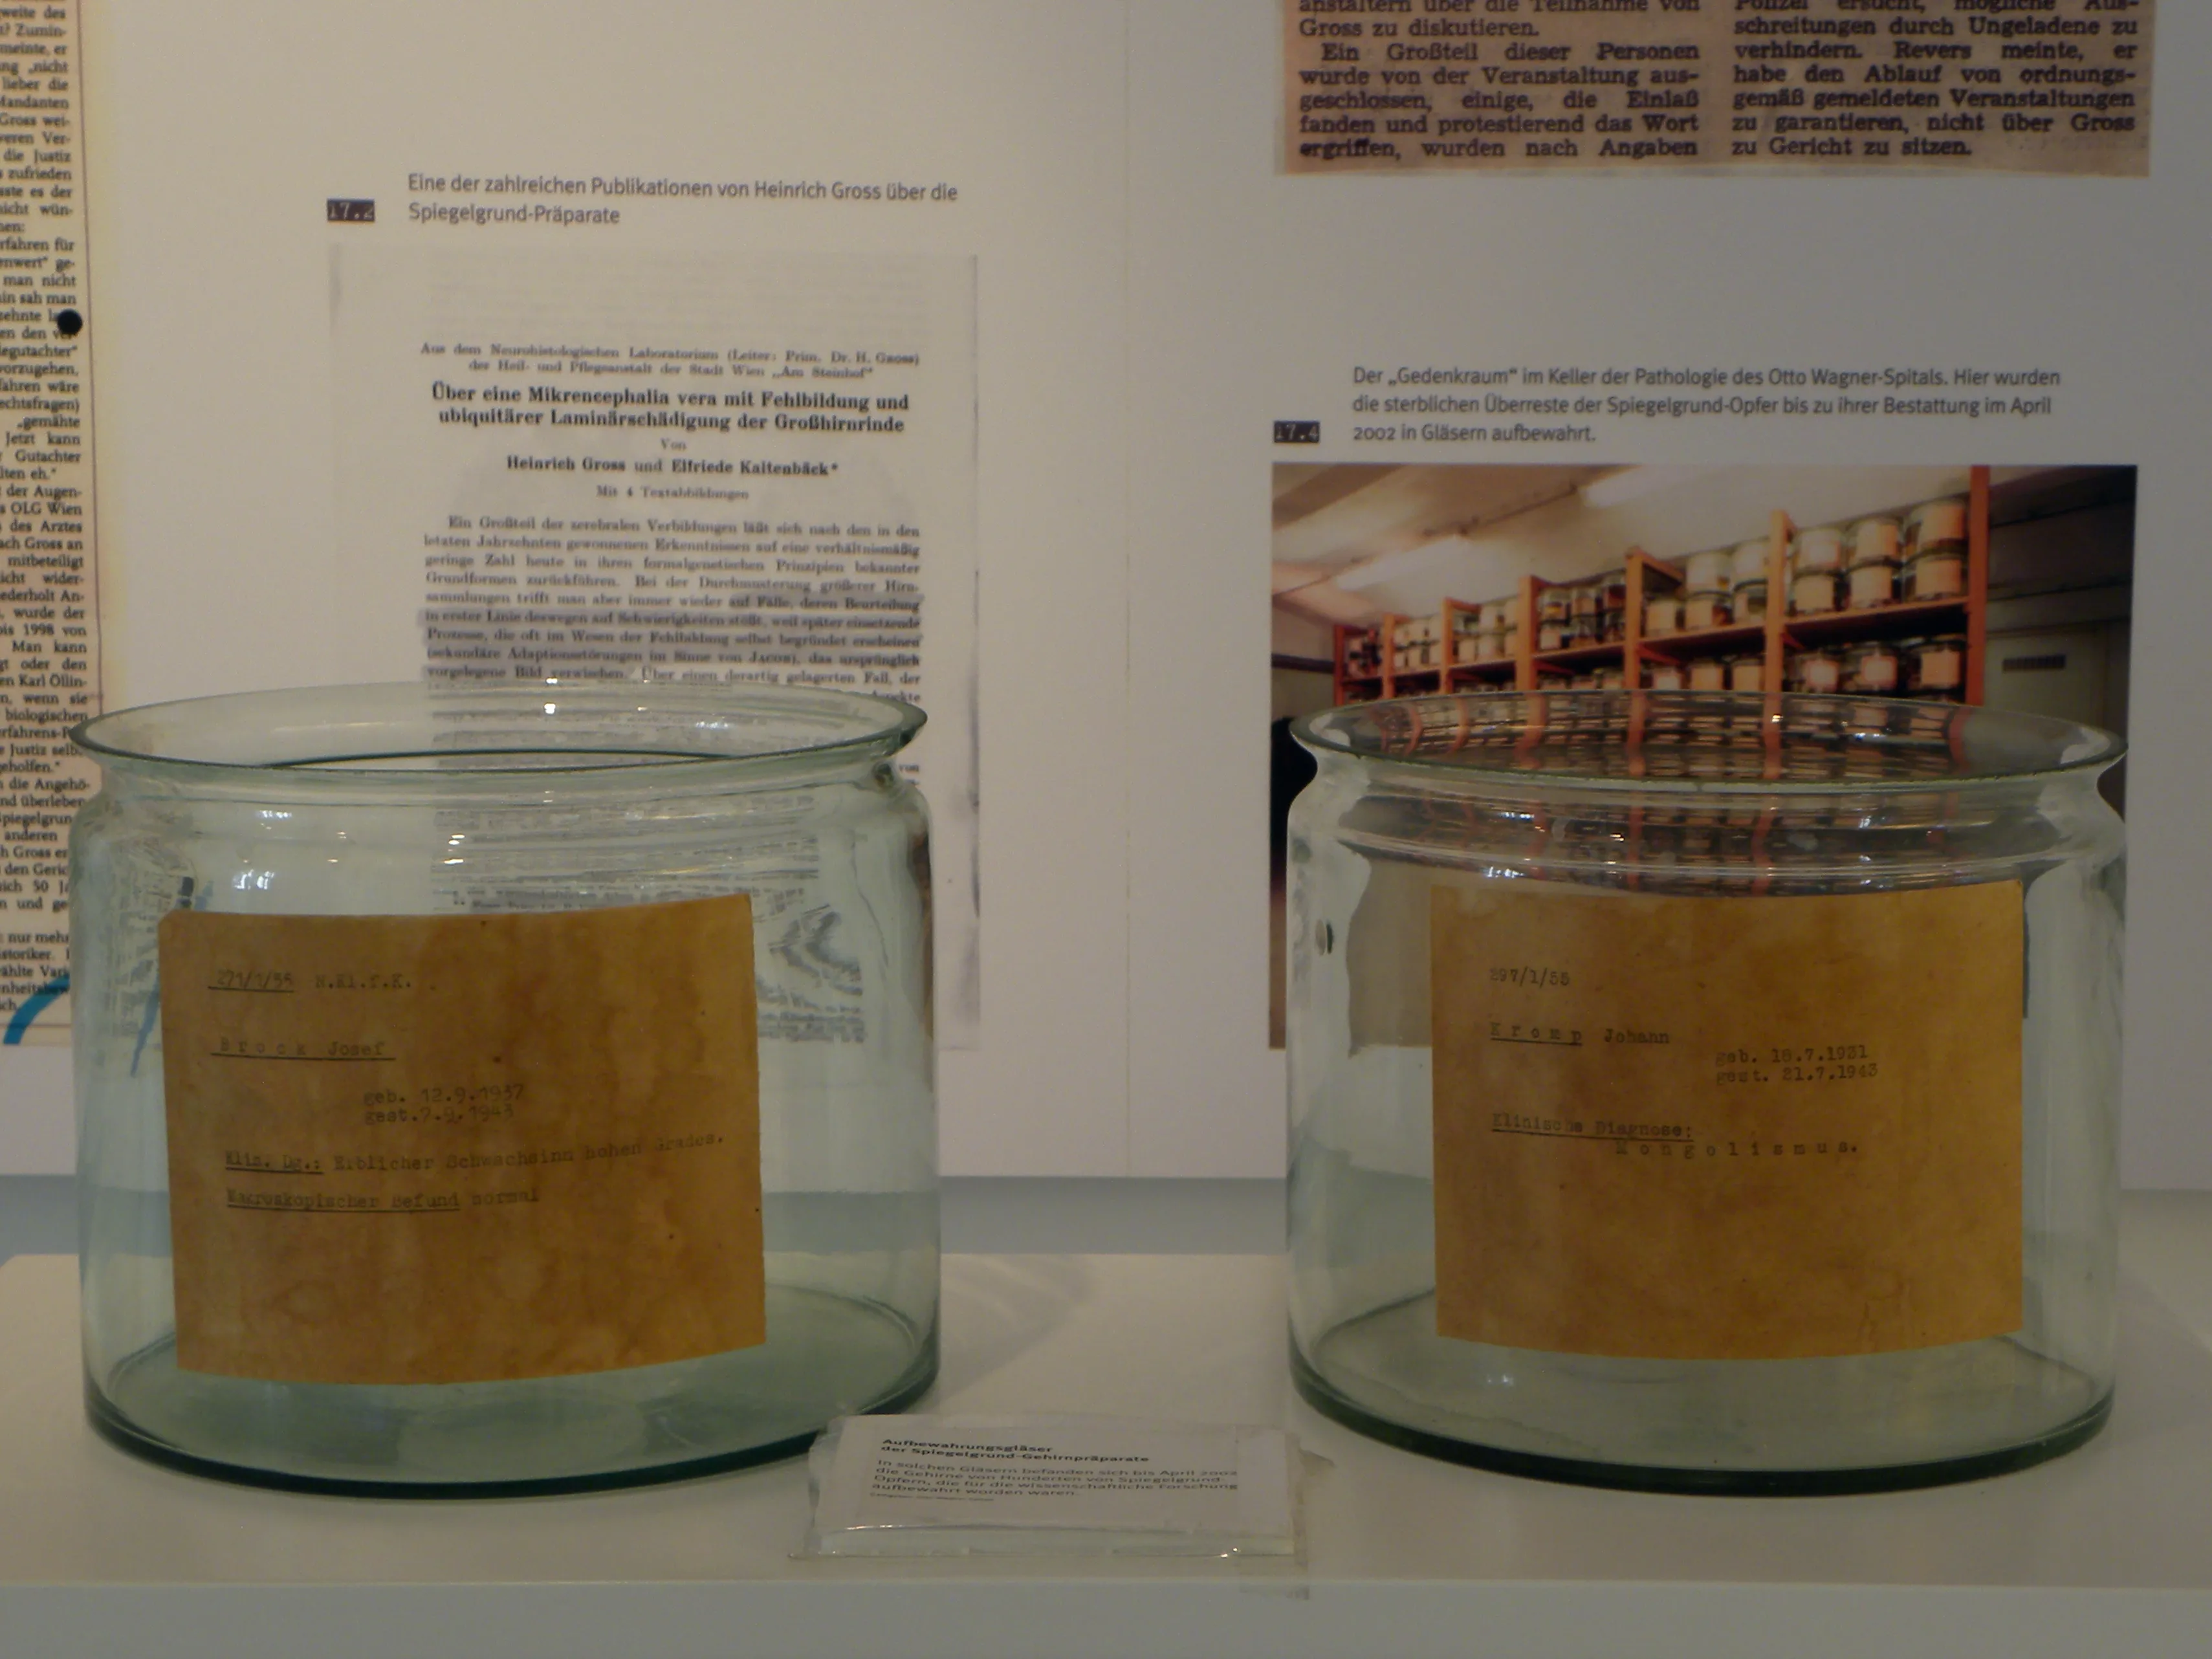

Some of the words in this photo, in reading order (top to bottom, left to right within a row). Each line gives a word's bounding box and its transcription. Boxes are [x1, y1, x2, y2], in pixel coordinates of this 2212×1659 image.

[1733, 16, 1877, 38] schreitungen
[1888, 16, 1955, 36] durch
[1967, 15, 2101, 39] Ungeladene
[2111, 20, 2138, 36] zu
[1298, 66, 1371, 86] wurde
[1379, 70, 1422, 86] von
[1431, 65, 1471, 85] der
[1480, 65, 1640, 89] Veranstaltung
[1733, 63, 1787, 83] habe
[1804, 63, 1845, 83] den
[1863, 63, 1943, 84] Ablauf
[1960, 68, 2002, 84] von
[2, 74, 40, 91] lieber
[47, 76, 69, 92] die
[1299, 114, 1375, 135] fanden
[1385, 114, 1429, 134] und
[1438, 113, 1584, 137] protestierend
[1593, 113, 1633, 133] das
[1641, 113, 1700, 133] Wort
[3, 148, 25, 162] die
[1731, 141, 1758, 156] zu
[1768, 136, 1853, 157] Gericht
[1863, 141, 1890, 157] zu
[1901, 137, 1973, 157] sitzen.
[8, 166, 72, 181] zufrieden
[408, 172, 446, 192] Eine
[450, 174, 481, 193] der
[484, 174, 587, 195] zahlreichen
[591, 176, 713, 198] Publikationen
[717, 183, 750, 198] von
[754, 180, 827, 199] Heinrich
[831, 181, 882, 201] Gross
[886, 182, 926, 201] über
[930, 182, 958, 202] die
[408, 201, 620, 227] Spiegelgrund-Präparate
[3, 276, 34, 287] man
[41, 272, 76, 288] nicht
[1353, 366, 1384, 385] Der
[1522, 368, 1544, 384] im
[1548, 368, 1597, 386] Keller
[1601, 368, 1630, 386] der
[1634, 367, 1728, 390] Pathologie
[1731, 368, 1764, 386] des
[1768, 368, 1807, 386] Otto
[1810, 368, 1949, 390] Wagner-Spitals.
[1953, 368, 1990, 386] Hier
[1993, 368, 2061, 386] wurden
[432, 380, 476, 402] Über
[483, 386, 521, 402] eine
[677, 393, 717, 406] vera
[724, 391, 754, 407] mit
[761, 391, 870, 413] Fehlbildung
[876, 394, 909, 411] und
[1352, 394, 1380, 413] die
[1383, 395, 1480, 413] sterblichen
[1484, 393, 1570, 414] Überreste
[1573, 396, 1603, 414] der
[1606, 395, 1779, 418] Spiegelgrund-Opfer
[1782, 396, 1809, 415] bis
[1812, 400, 1834, 415] zu
[1837, 396, 1879, 415] ihrer
[1883, 396, 1981, 419] Bestattung
[1984, 397, 2006, 414] im
[2009, 396, 2052, 418] April
[737, 413, 768, 430] der
[774, 413, 904, 433] Großhirnrinde
[47, 431, 81, 446] kann
[1353, 426, 1396, 442] 2002
[1401, 423, 1418, 441] in
[1421, 423, 1487, 442] Gläsern
[1491, 423, 1596, 443] aufbewahrt.
[660, 437, 687, 451] Von
[14, 448, 82, 463] Gutachter
[507, 455, 576, 471] Heinrich
[582, 457, 626, 472] Gross
[634, 459, 663, 473] und
[672, 459, 734, 474] Elfriede
[6, 483, 28, 498] der
[47, 501, 83, 516] Wien
[24, 536, 63, 551] Gross
[66, 540, 83, 551] an
[7, 553, 84, 571] mitbeteiligt
[12, 639, 42, 654] Man
[53, 639, 87, 654] kann
[20, 656, 50, 671] oder
